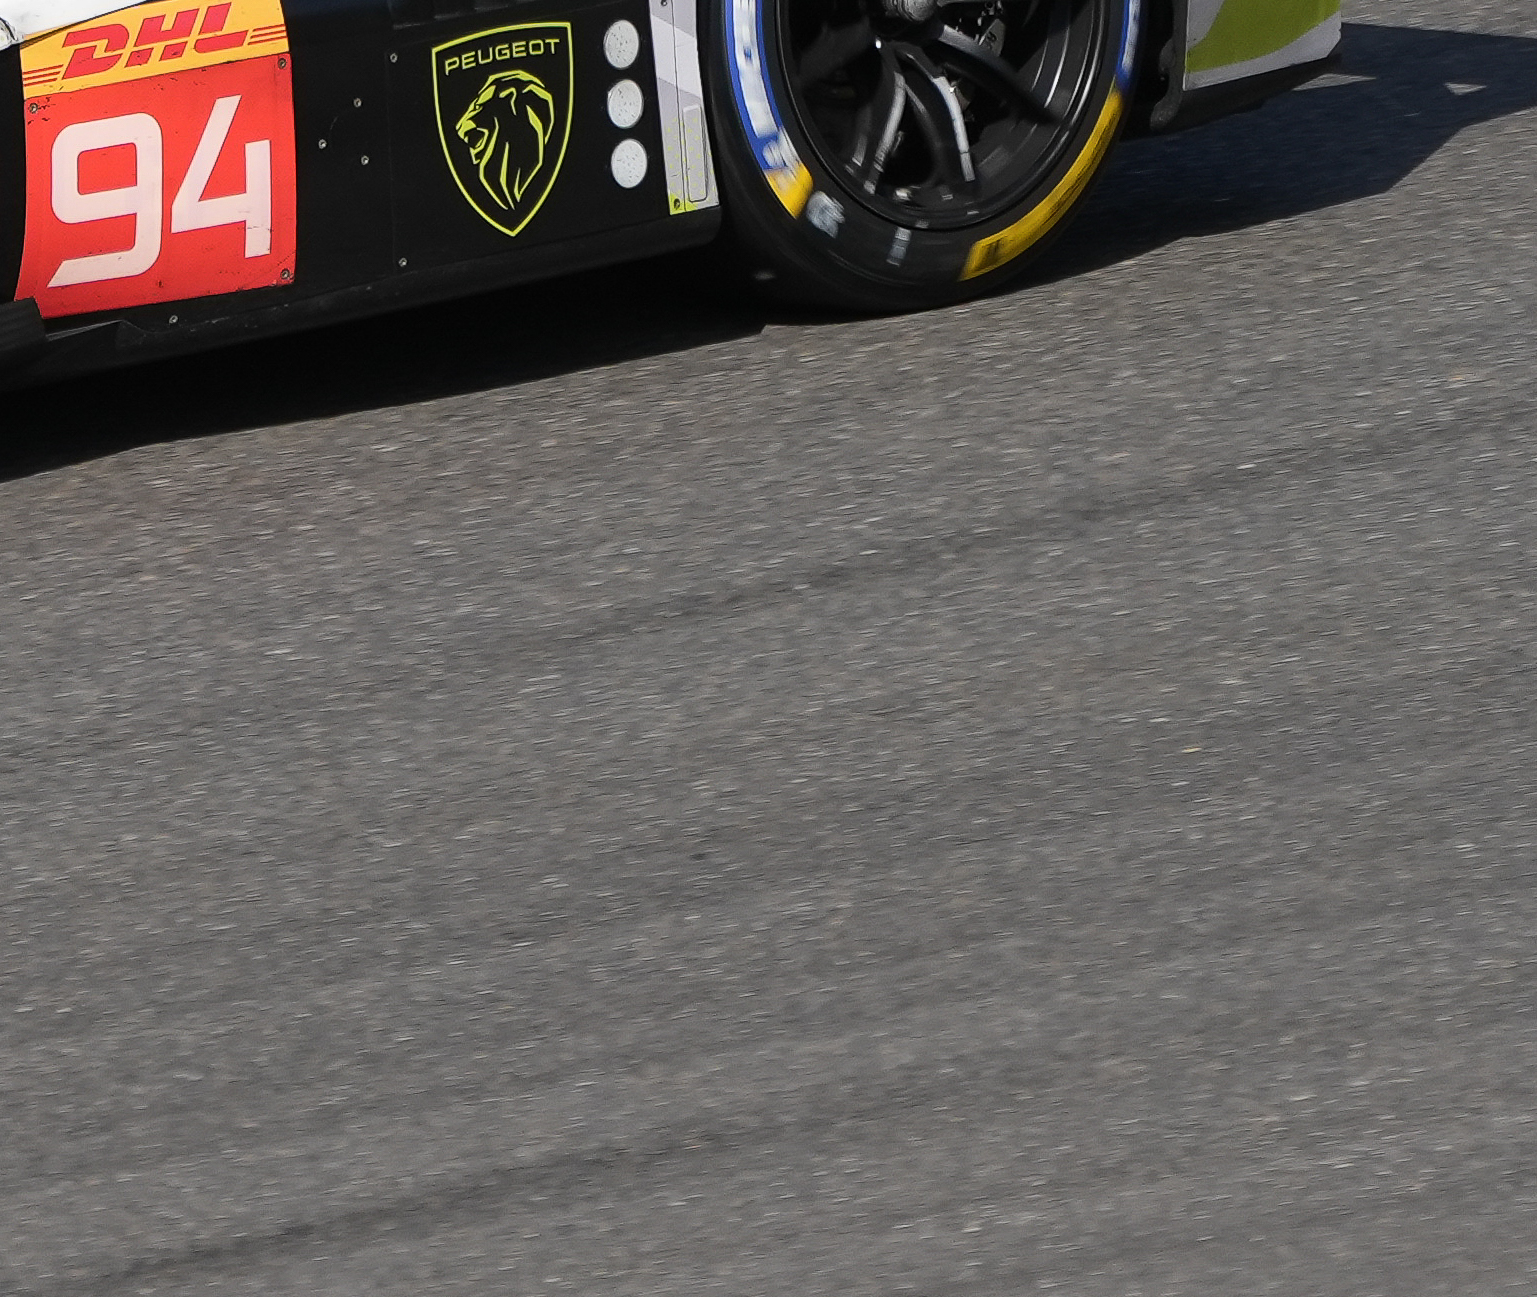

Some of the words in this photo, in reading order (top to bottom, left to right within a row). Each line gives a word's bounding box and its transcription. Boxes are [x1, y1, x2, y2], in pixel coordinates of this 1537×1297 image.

[62, 2, 248, 81] DHL
[445, 37, 561, 77] PEUGEOT
[47, 95, 273, 290] 94
